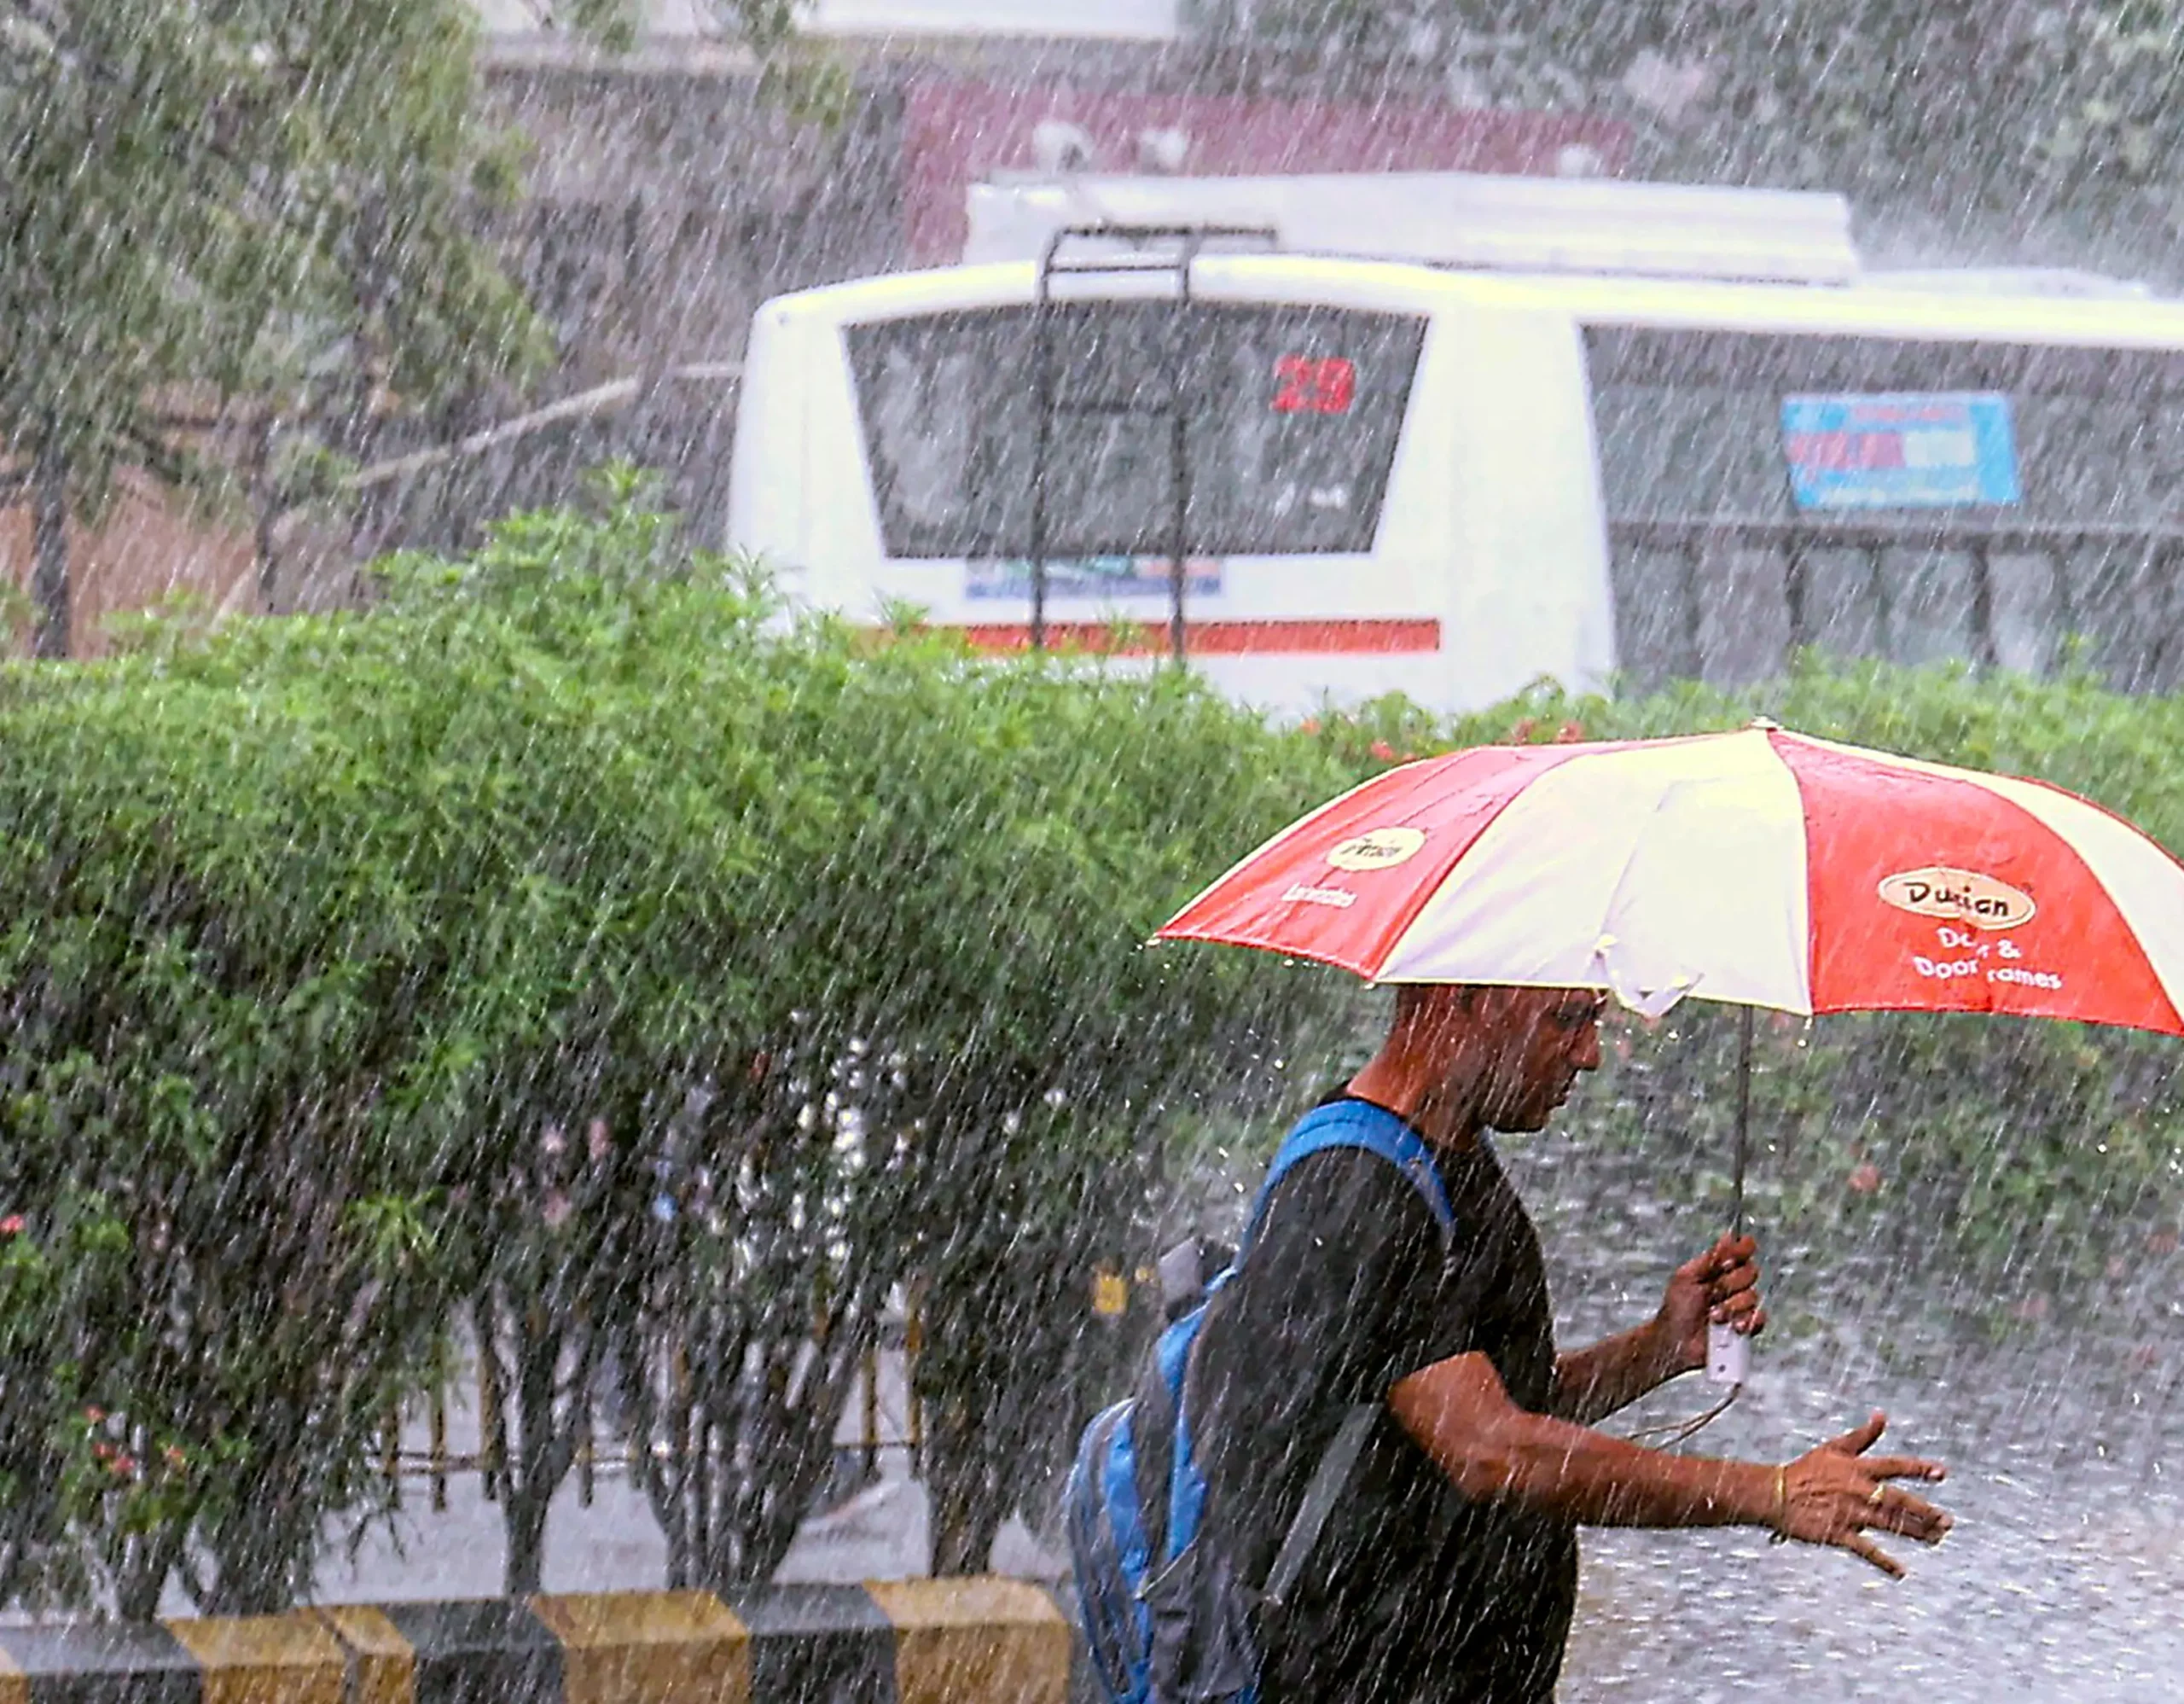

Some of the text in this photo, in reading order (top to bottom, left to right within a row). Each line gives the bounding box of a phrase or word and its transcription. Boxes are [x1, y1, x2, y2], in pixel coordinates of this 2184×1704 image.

[1997, 939, 2022, 959] &
[1913, 956, 2063, 990] Door rames
